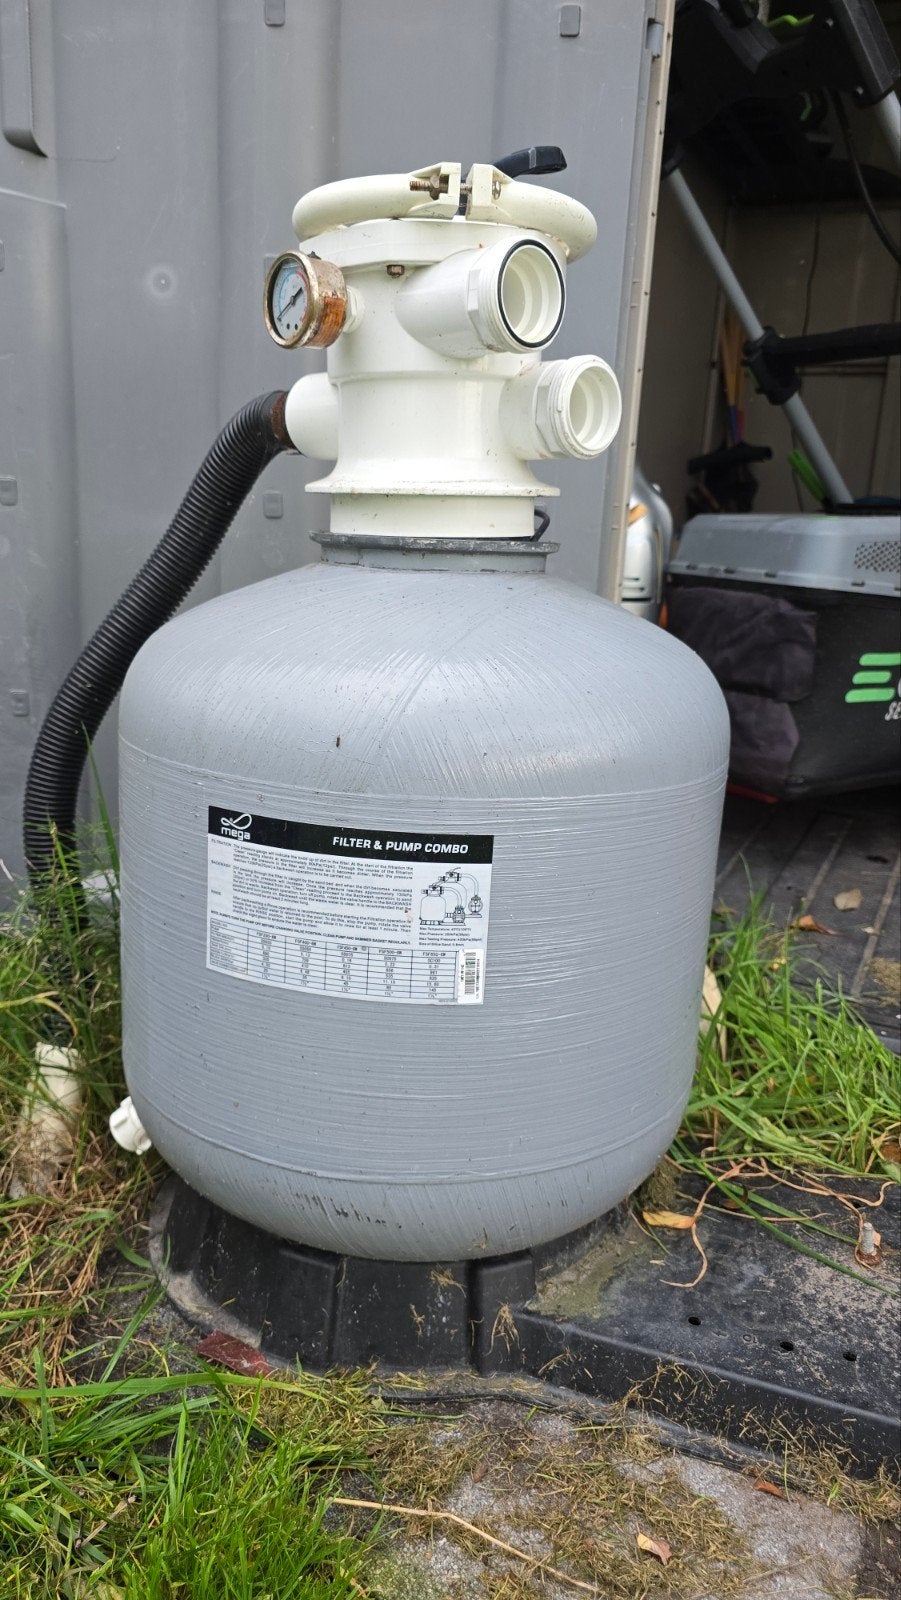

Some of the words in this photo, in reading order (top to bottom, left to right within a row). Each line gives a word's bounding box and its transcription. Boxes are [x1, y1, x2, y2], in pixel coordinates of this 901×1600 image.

[221, 827, 251, 841] mega
[332, 836, 371, 849] FILTER
[373, 840, 383, 850] &
[385, 841, 422, 852] PUMP
[424, 843, 469, 854] COMBO
